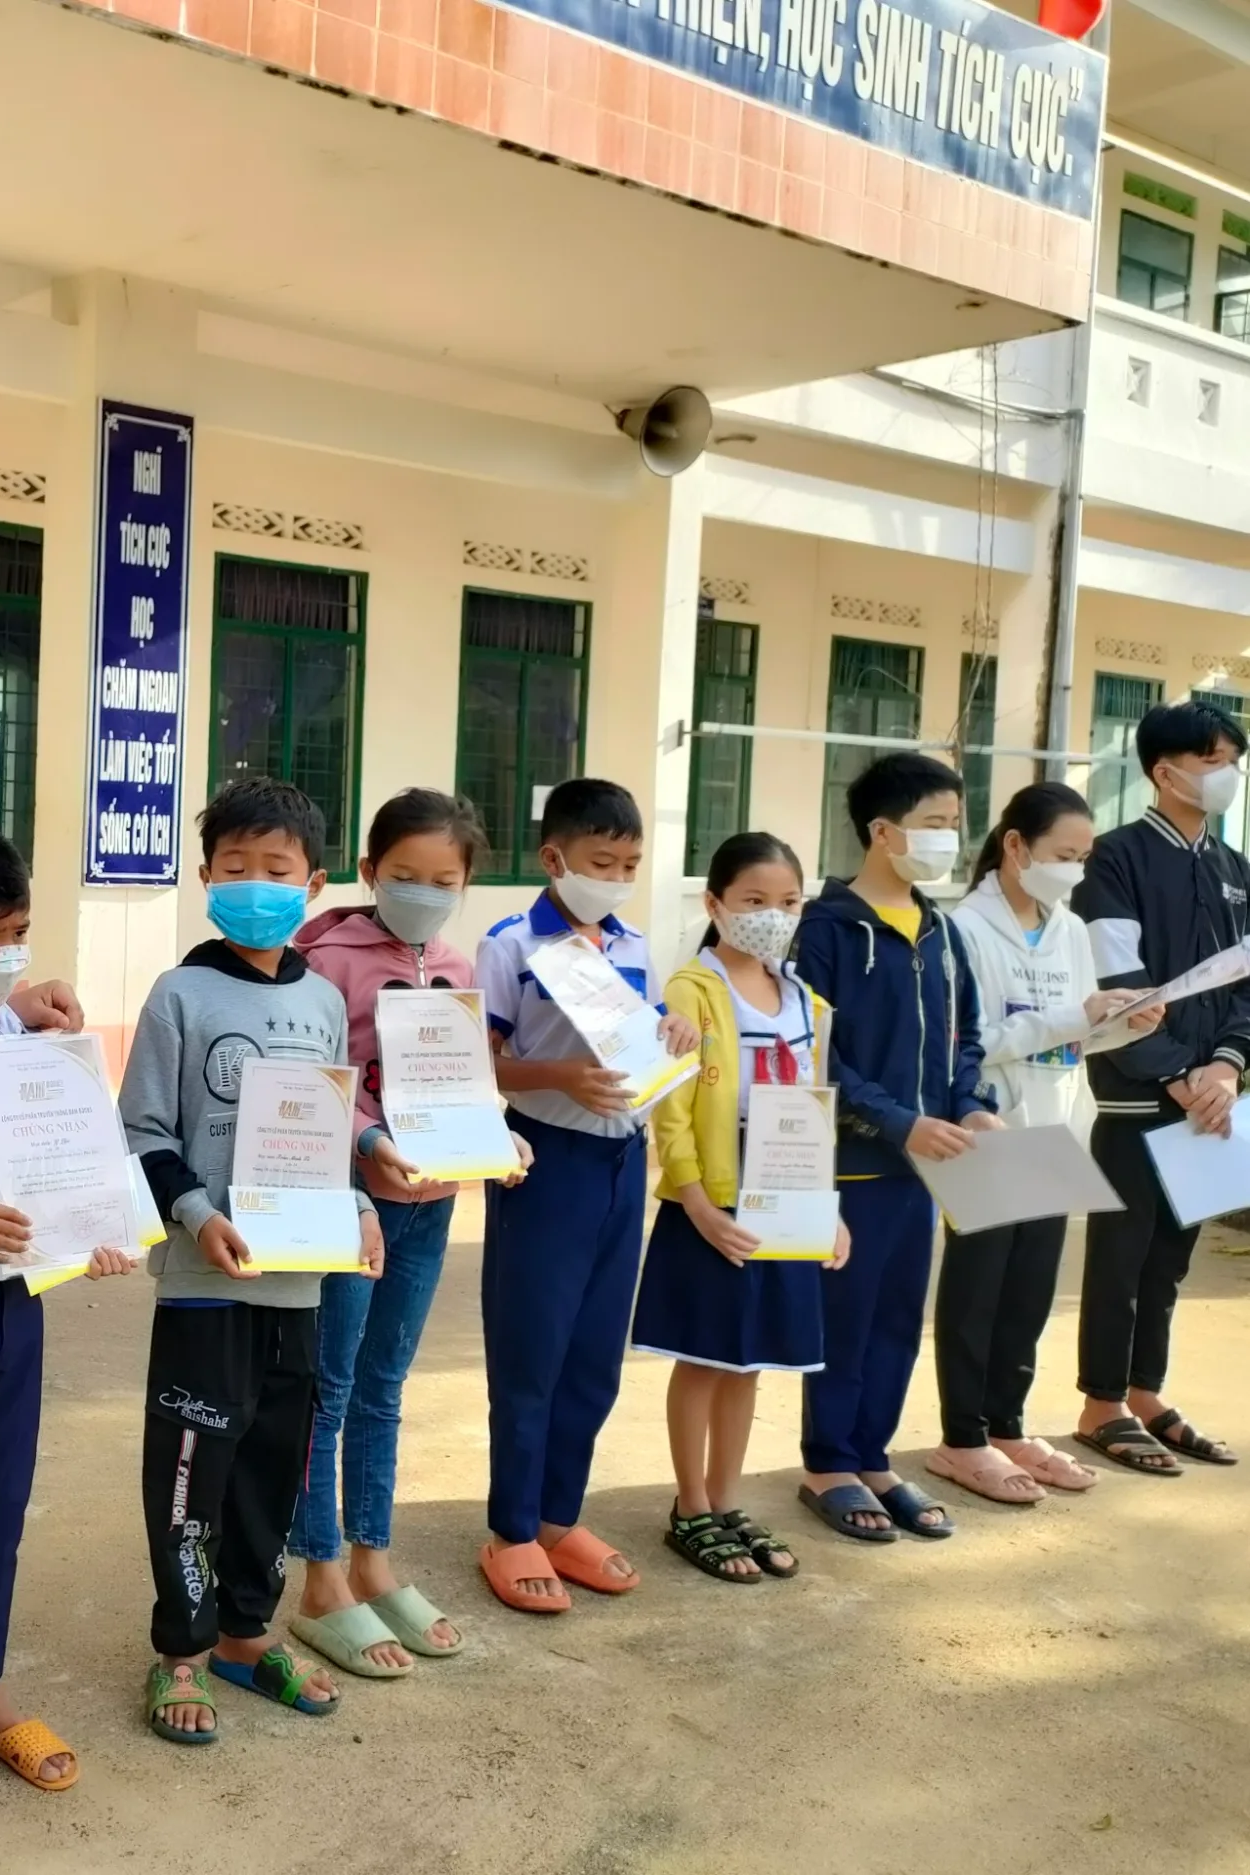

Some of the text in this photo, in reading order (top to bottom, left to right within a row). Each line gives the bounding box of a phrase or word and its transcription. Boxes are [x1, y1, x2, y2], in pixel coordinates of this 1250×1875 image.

[777, 0, 847, 101] HỌC
[853, 0, 932, 121] SINH
[936, 19, 1005, 149] TÍCH
[120, 513, 170, 578] TÍCH CỰC
[130, 596, 154, 648] HỌC
[102, 658, 178, 714] CHĂM NGOAN
[99, 728, 176, 792] LÀM VIỆC TỐT
[100, 798, 170, 856] SỐNG CÓ ÍCH
